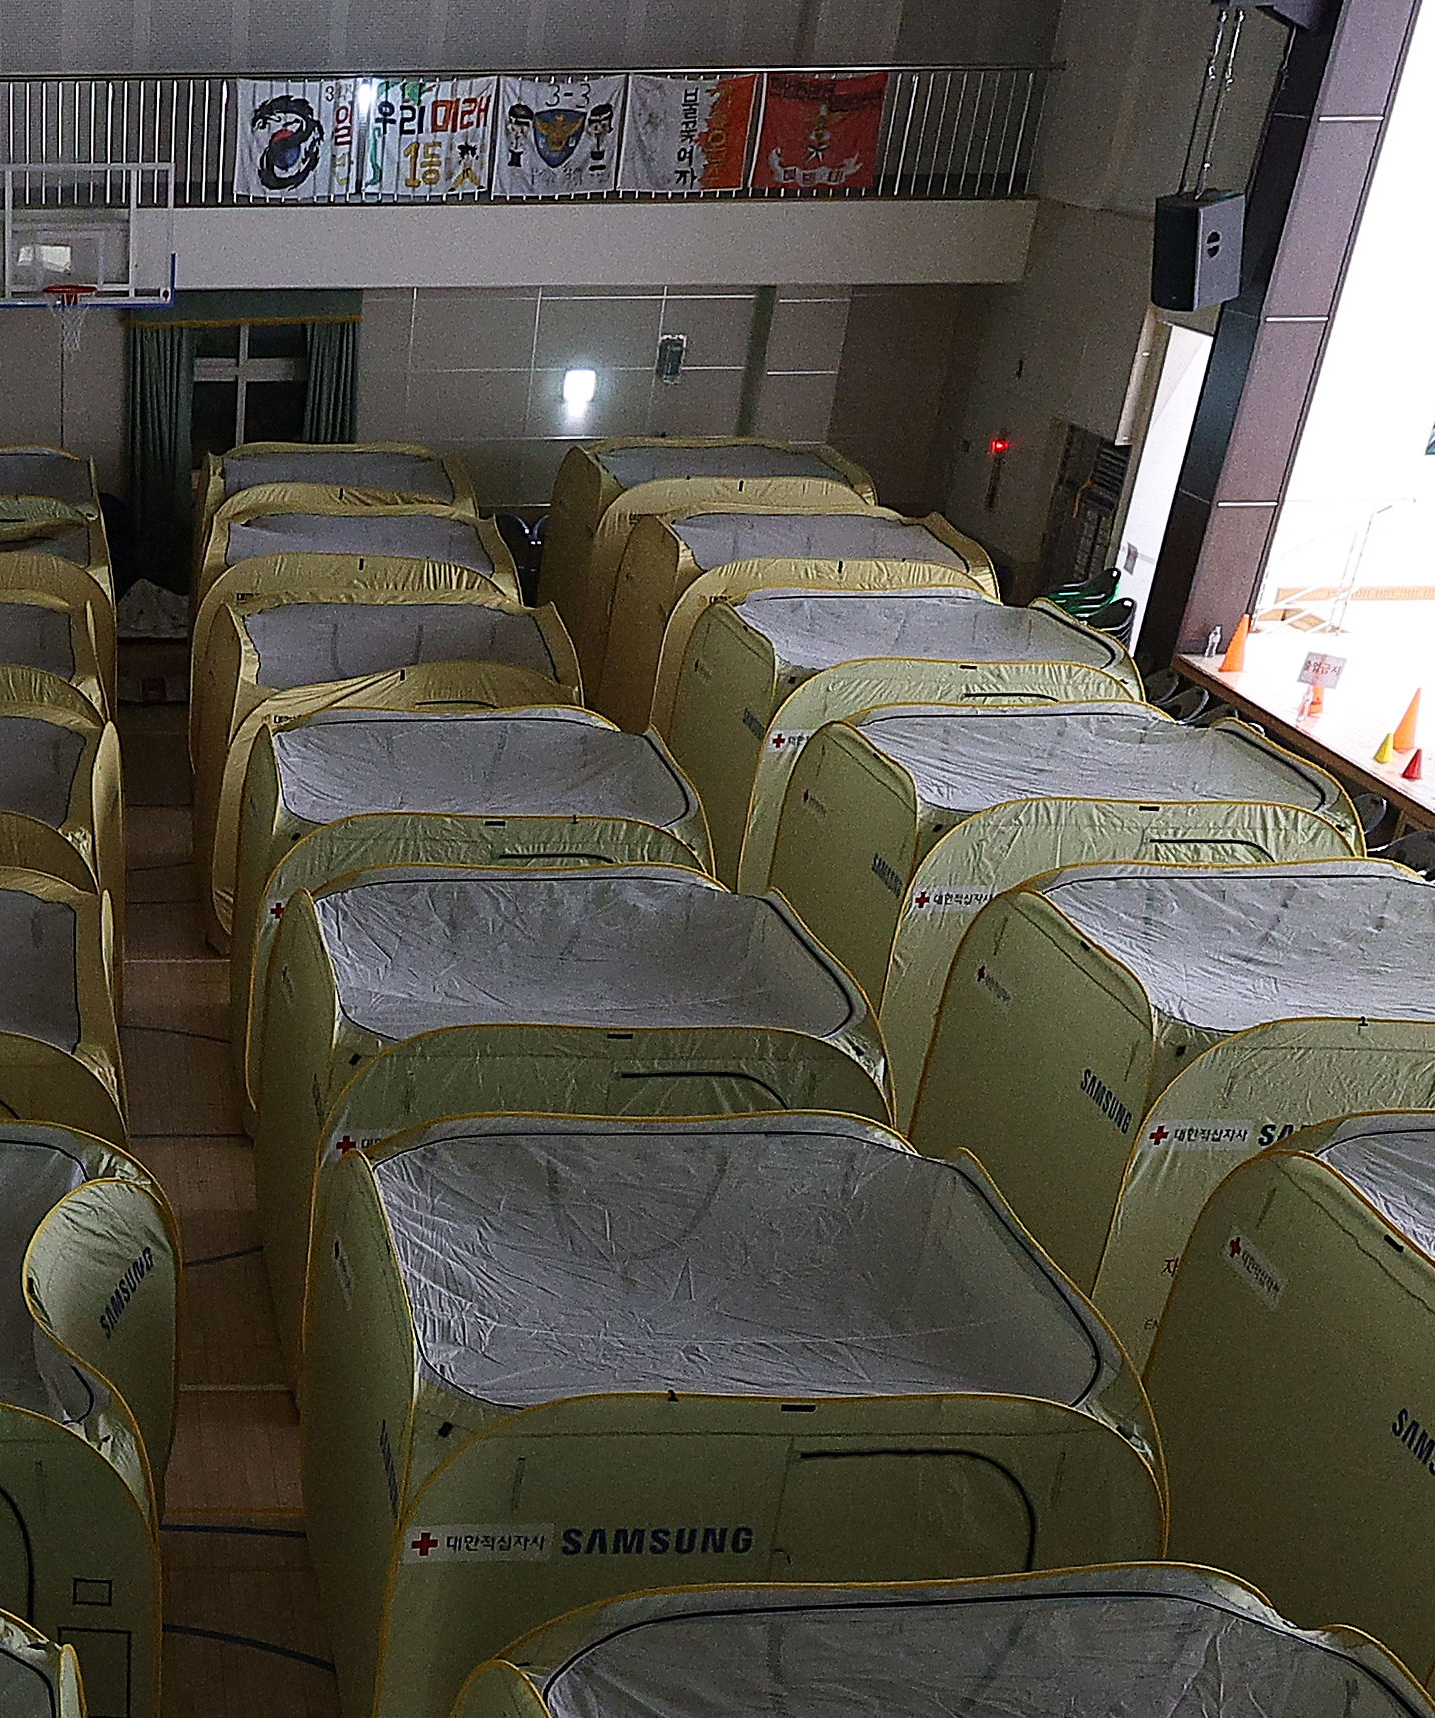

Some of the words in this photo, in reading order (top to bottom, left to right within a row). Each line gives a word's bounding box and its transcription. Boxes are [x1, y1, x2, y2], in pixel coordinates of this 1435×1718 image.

[375, 100, 426, 135] 우리
[430, 94, 492, 134] 미래
[1081, 1068, 1132, 1135] SAMSUNG
[1174, 1126, 1249, 1143] 대한적십자사
[100, 1245, 155, 1339] SAMSUNG
[446, 1534, 545, 1552] 대한적십자사
[561, 1526, 754, 1556] SAMSUNG
